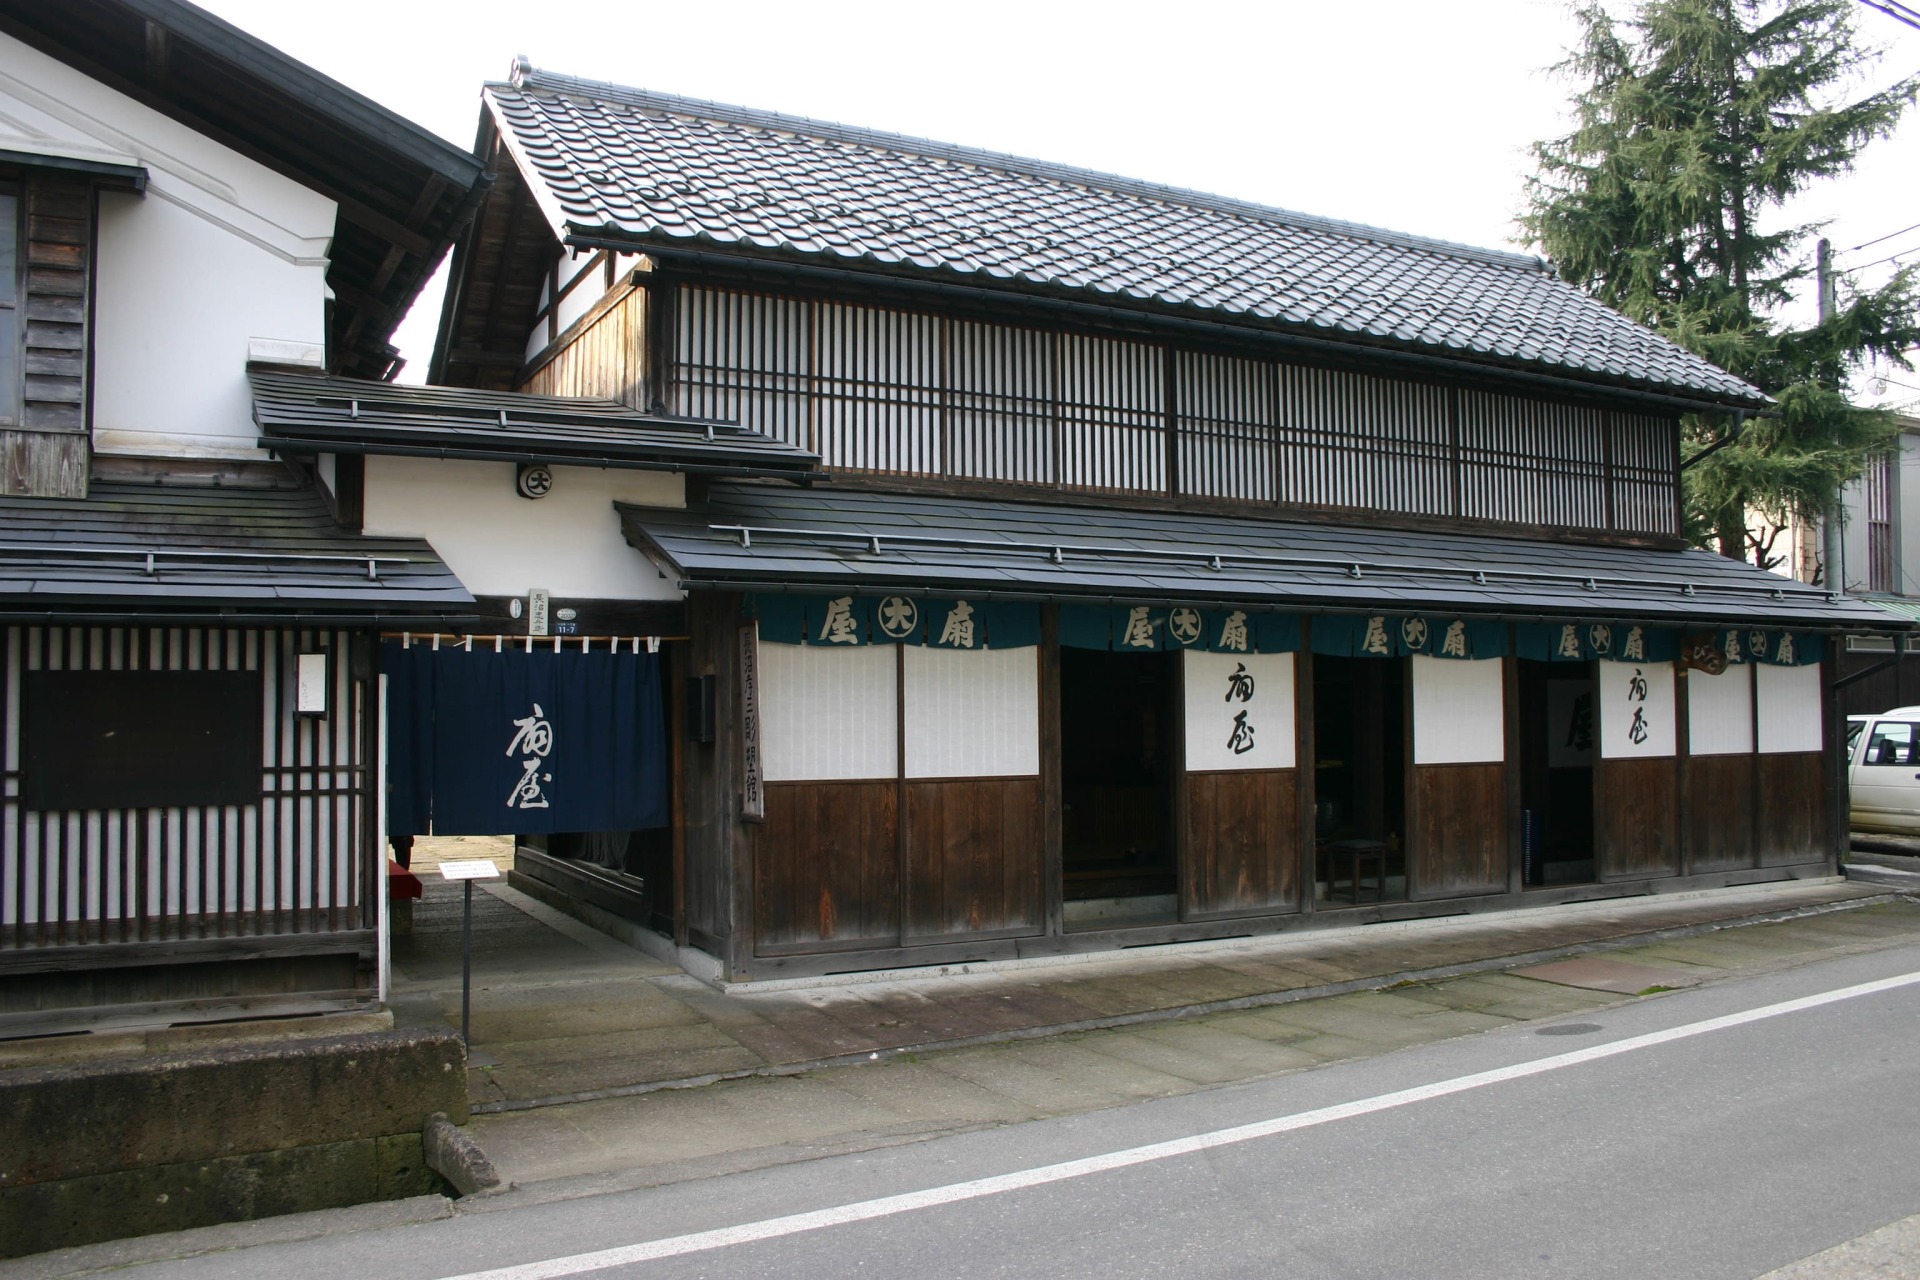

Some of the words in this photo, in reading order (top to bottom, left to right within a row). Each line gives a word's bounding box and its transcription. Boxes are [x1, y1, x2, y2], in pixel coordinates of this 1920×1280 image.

[818, 596, 858, 645] 屋
[938, 600, 975, 649] 扇
[1122, 606, 1155, 649] 屋
[1219, 610, 1248, 652] 扇
[1362, 616, 1388, 655] 屋
[1442, 619, 1466, 657] 扇
[1558, 624, 1580, 658] 屋
[1624, 626, 1643, 659] 扇
[1776, 631, 1793, 664] 扇
